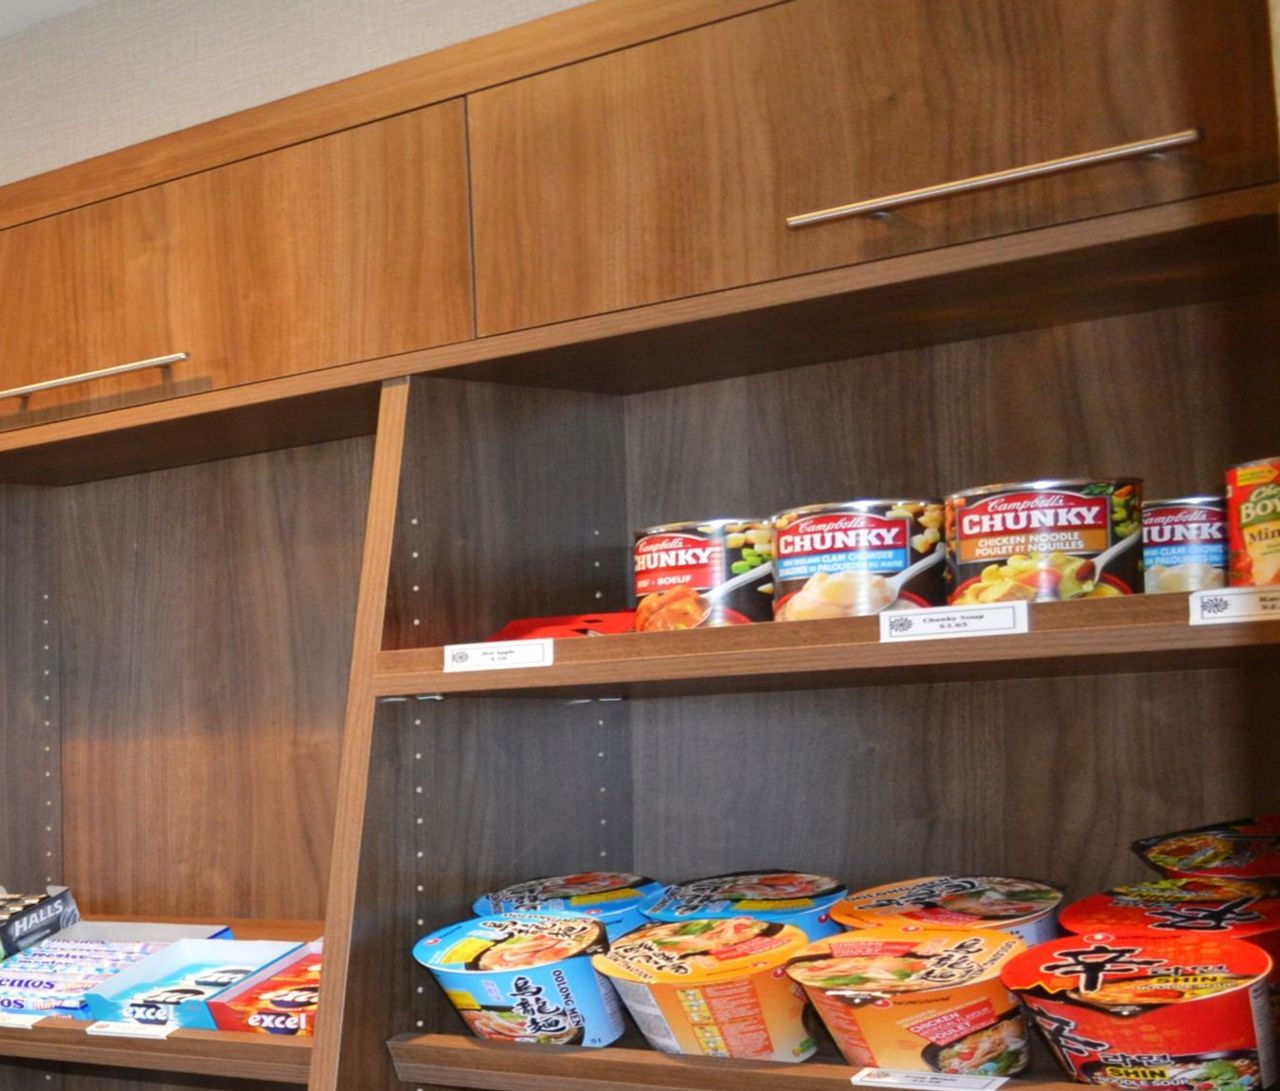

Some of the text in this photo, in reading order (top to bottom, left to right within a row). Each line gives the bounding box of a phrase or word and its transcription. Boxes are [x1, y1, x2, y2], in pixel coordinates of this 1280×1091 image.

[962, 506, 1101, 535] CHUNKY
[780, 528, 900, 554] CHUNKY
[975, 545, 1013, 557] POULET
[1028, 540, 1084, 553] NOUILLES
[978, 532, 1080, 549] CHICKEN NOODLE
[634, 547, 714, 571] HUNKY
[14, 900, 64, 937] HALLS
[552, 969, 575, 1014] OOLONG
[248, 1014, 307, 1029] excel
[910, 1012, 960, 1033] CHICKEN
[1109, 1068, 1167, 1078] SHIN
